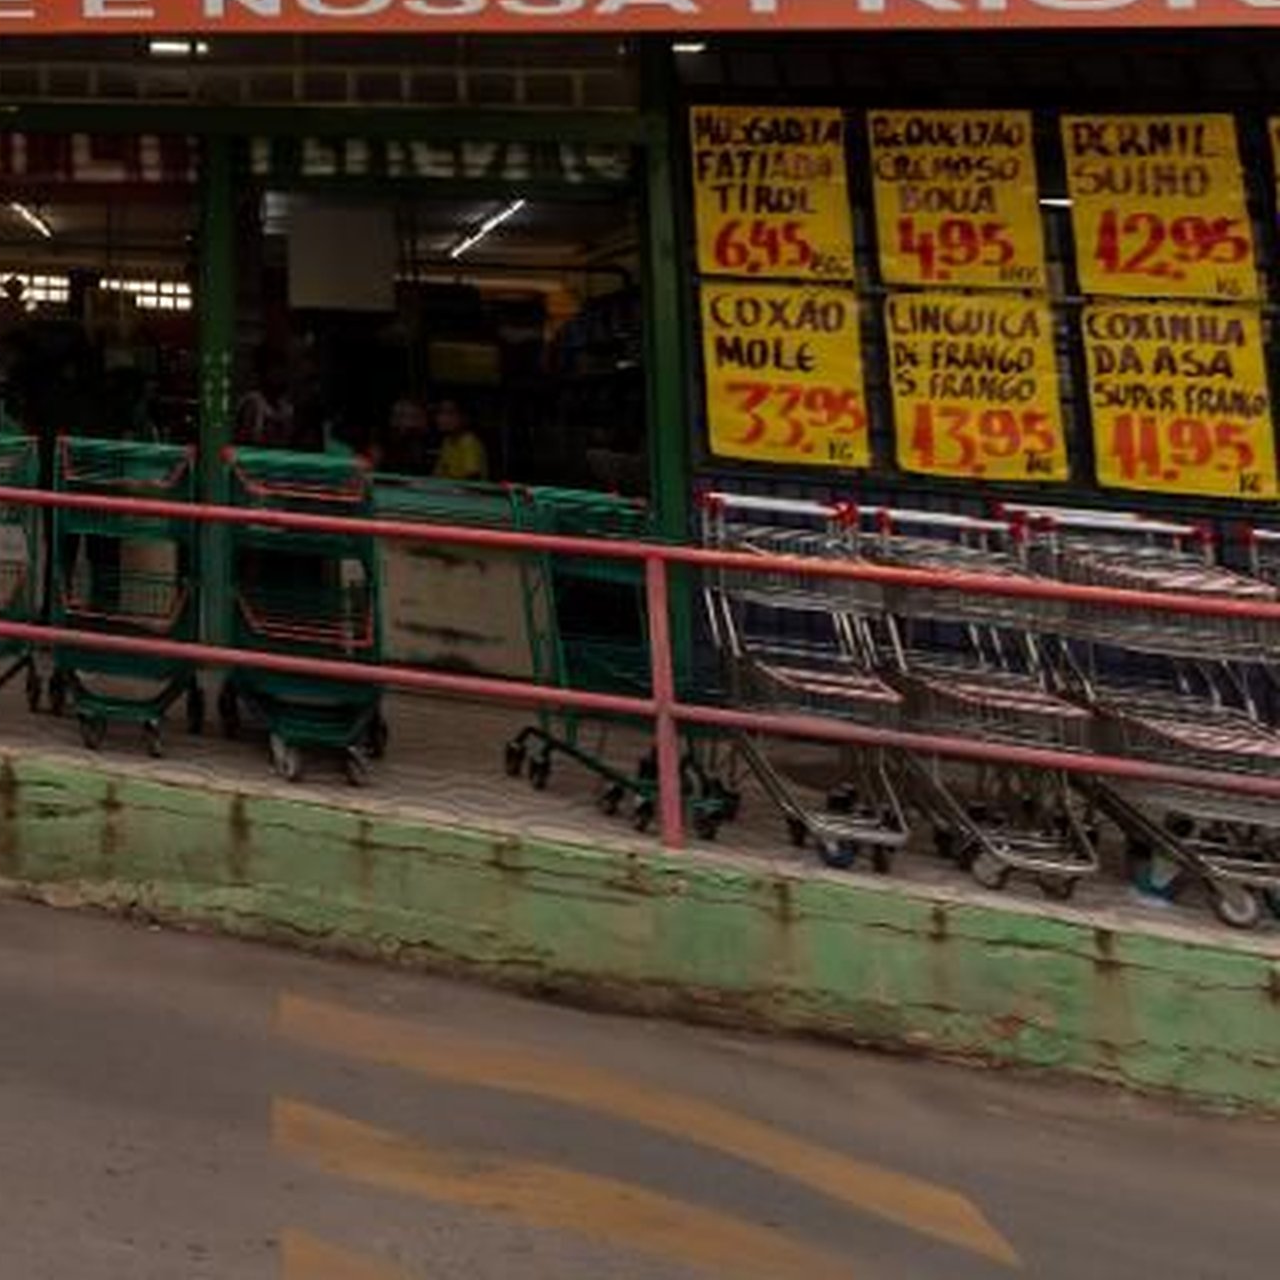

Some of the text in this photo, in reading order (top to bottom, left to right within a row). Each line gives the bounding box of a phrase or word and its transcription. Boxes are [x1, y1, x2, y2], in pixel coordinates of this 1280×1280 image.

[710, 184, 816, 214] TIROL
[931, 341, 1035, 373] FRANGO
[1093, 343, 1234, 379] DA ASA
[930, 372, 1037, 402] FRANGO
